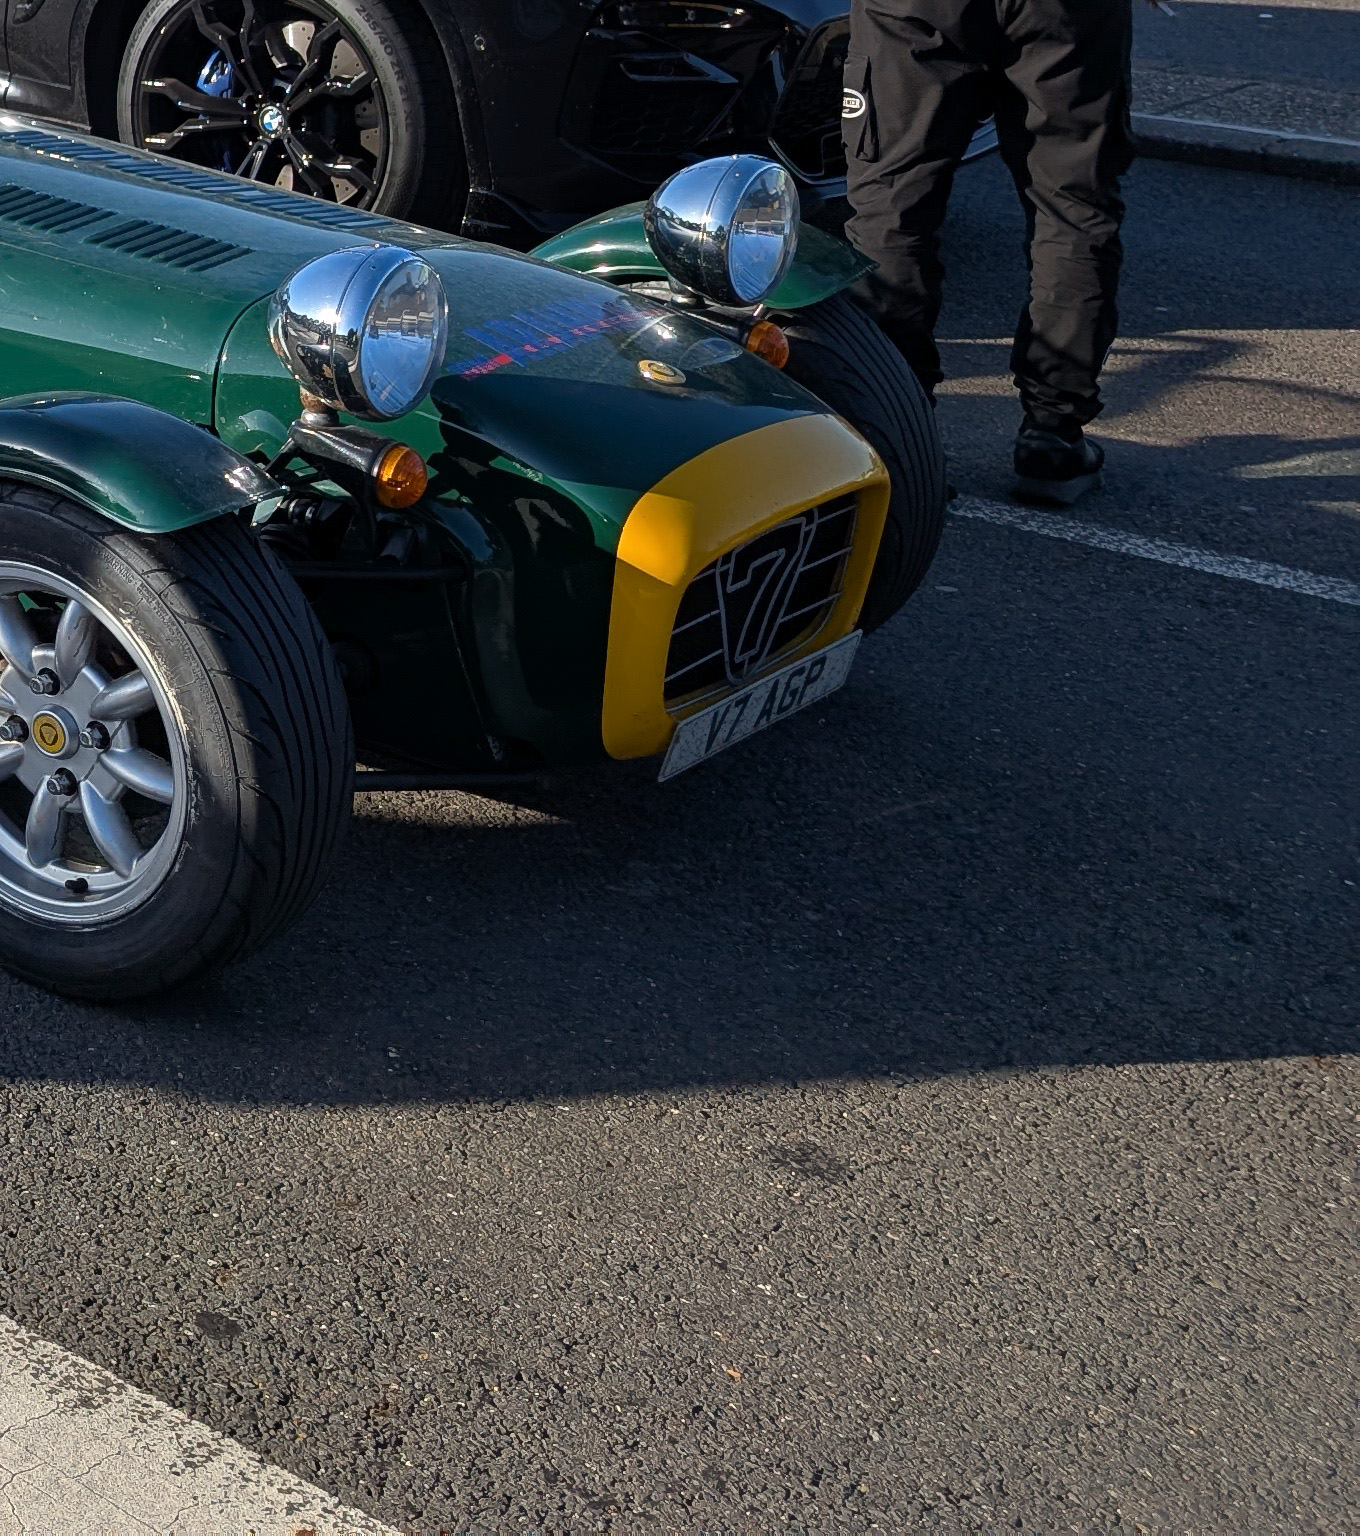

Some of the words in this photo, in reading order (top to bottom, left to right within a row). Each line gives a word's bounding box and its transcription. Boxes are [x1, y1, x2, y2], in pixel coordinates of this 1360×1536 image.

[354, 4, 395, 57] 255/40
[703, 694, 753, 755] V7
[755, 654, 829, 729] AGP
